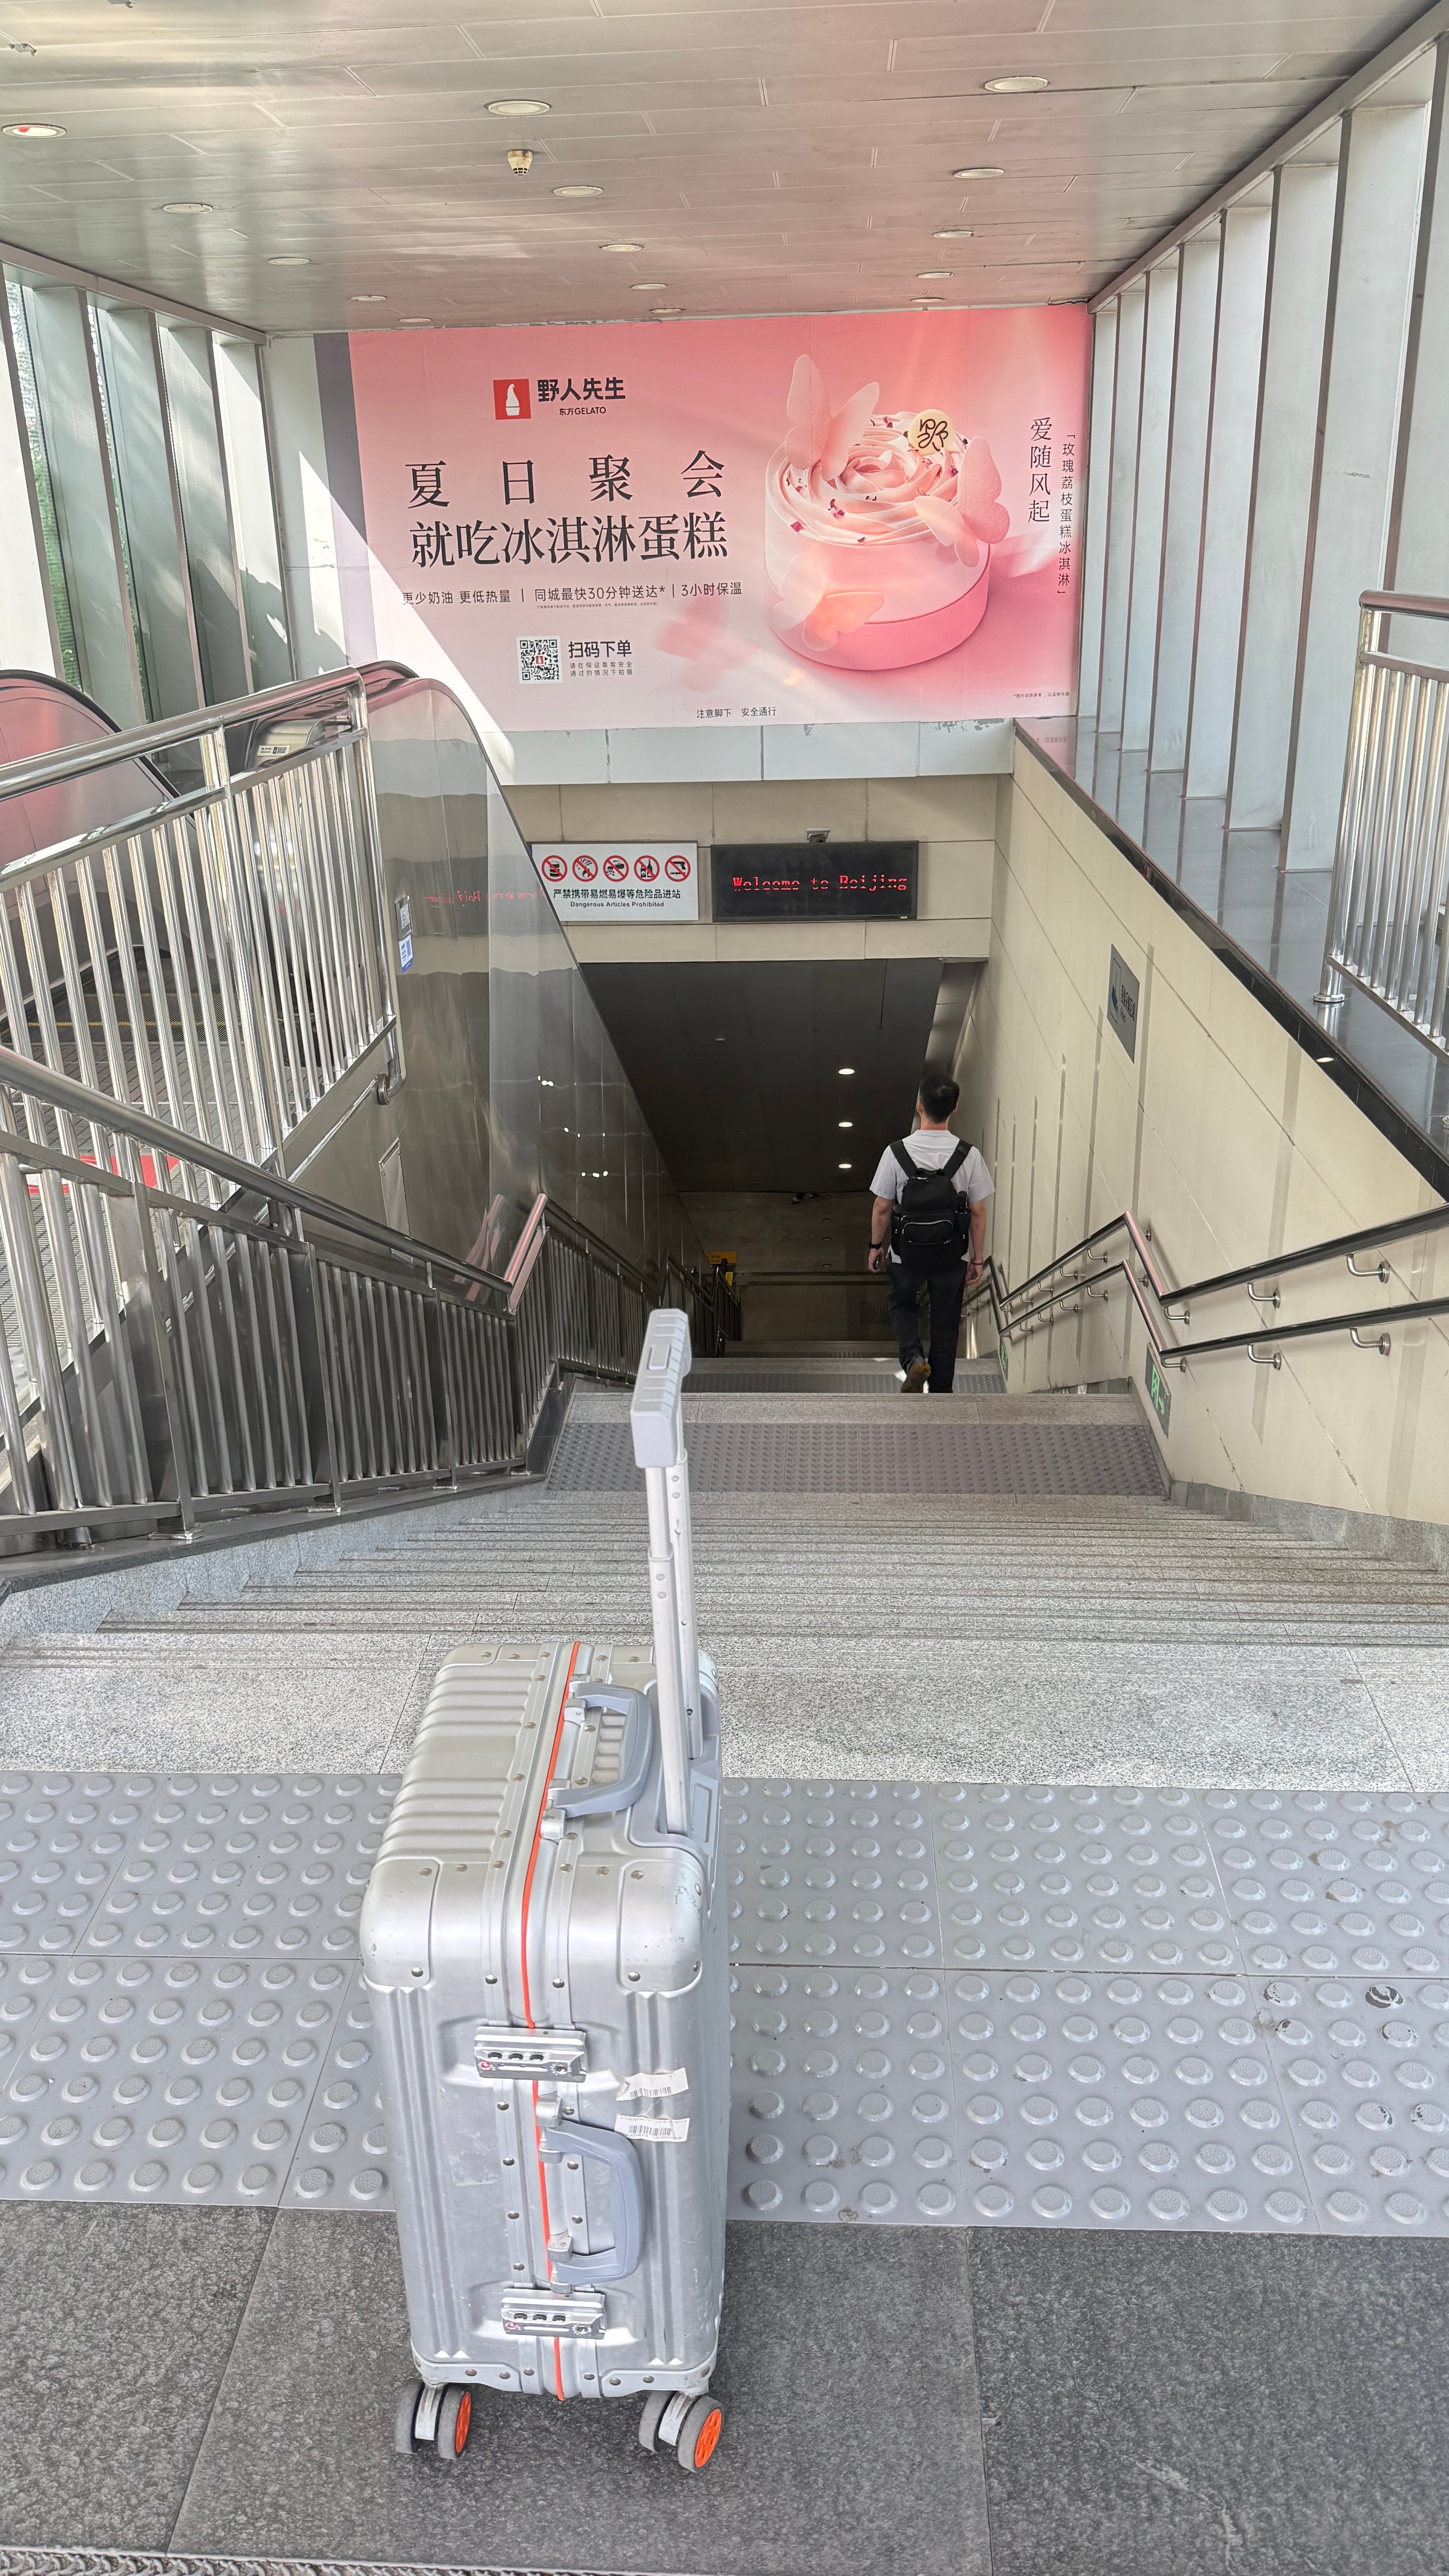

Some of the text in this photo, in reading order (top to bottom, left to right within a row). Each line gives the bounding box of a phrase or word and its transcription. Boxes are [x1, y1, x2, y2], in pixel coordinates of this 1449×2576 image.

[537, 377, 626, 402] 野人先生
[559, 407, 606, 415] 东方GELATO
[1028, 417, 1052, 523] 爱随风起
[409, 511, 728, 568] 就吃冰淇淋蛋糕
[402, 591, 453, 605] 更少奶油
[459, 589, 511, 604] 更低热量
[681, 582, 742, 596] 3小时保温
[568, 639, 632, 658] 扫码下单
[697, 706, 777, 718] 注意脚下 安全通行
[811, 877, 829, 890] to
[553, 889, 681, 899] 严禁携带易燃易爆等危险品进站
